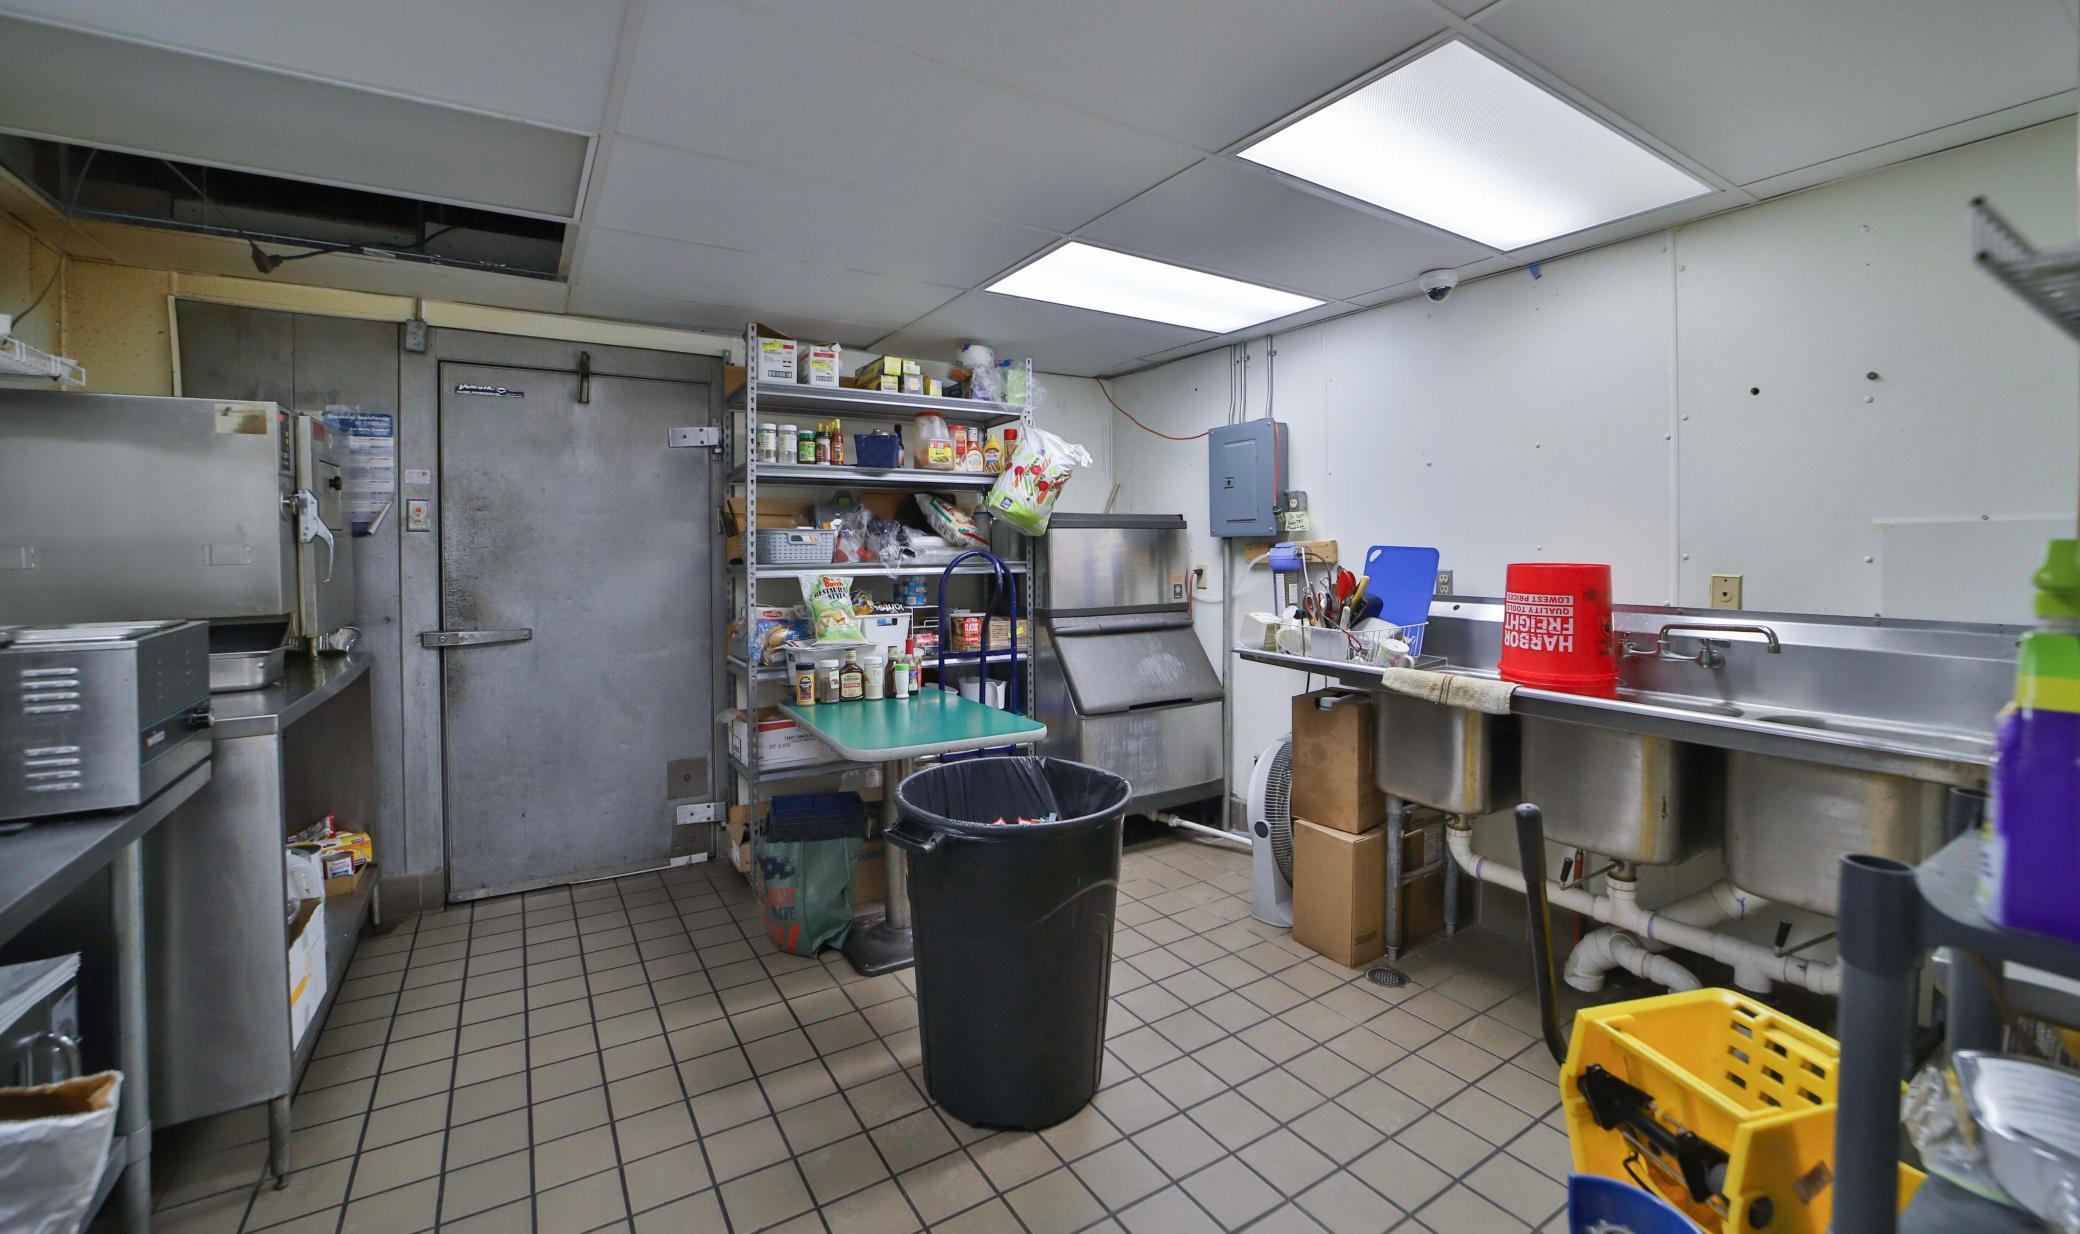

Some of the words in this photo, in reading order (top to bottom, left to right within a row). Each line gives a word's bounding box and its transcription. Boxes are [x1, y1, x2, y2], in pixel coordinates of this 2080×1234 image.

[1507, 593, 1529, 602] PRICES
[1532, 595, 1570, 604] LOWEST
[1507, 604, 1526, 613] TOOLS
[1529, 606, 1570, 615] QUALITY
[1504, 613, 1574, 635] FREIGHT
[1504, 629, 1573, 653] HARBOR
